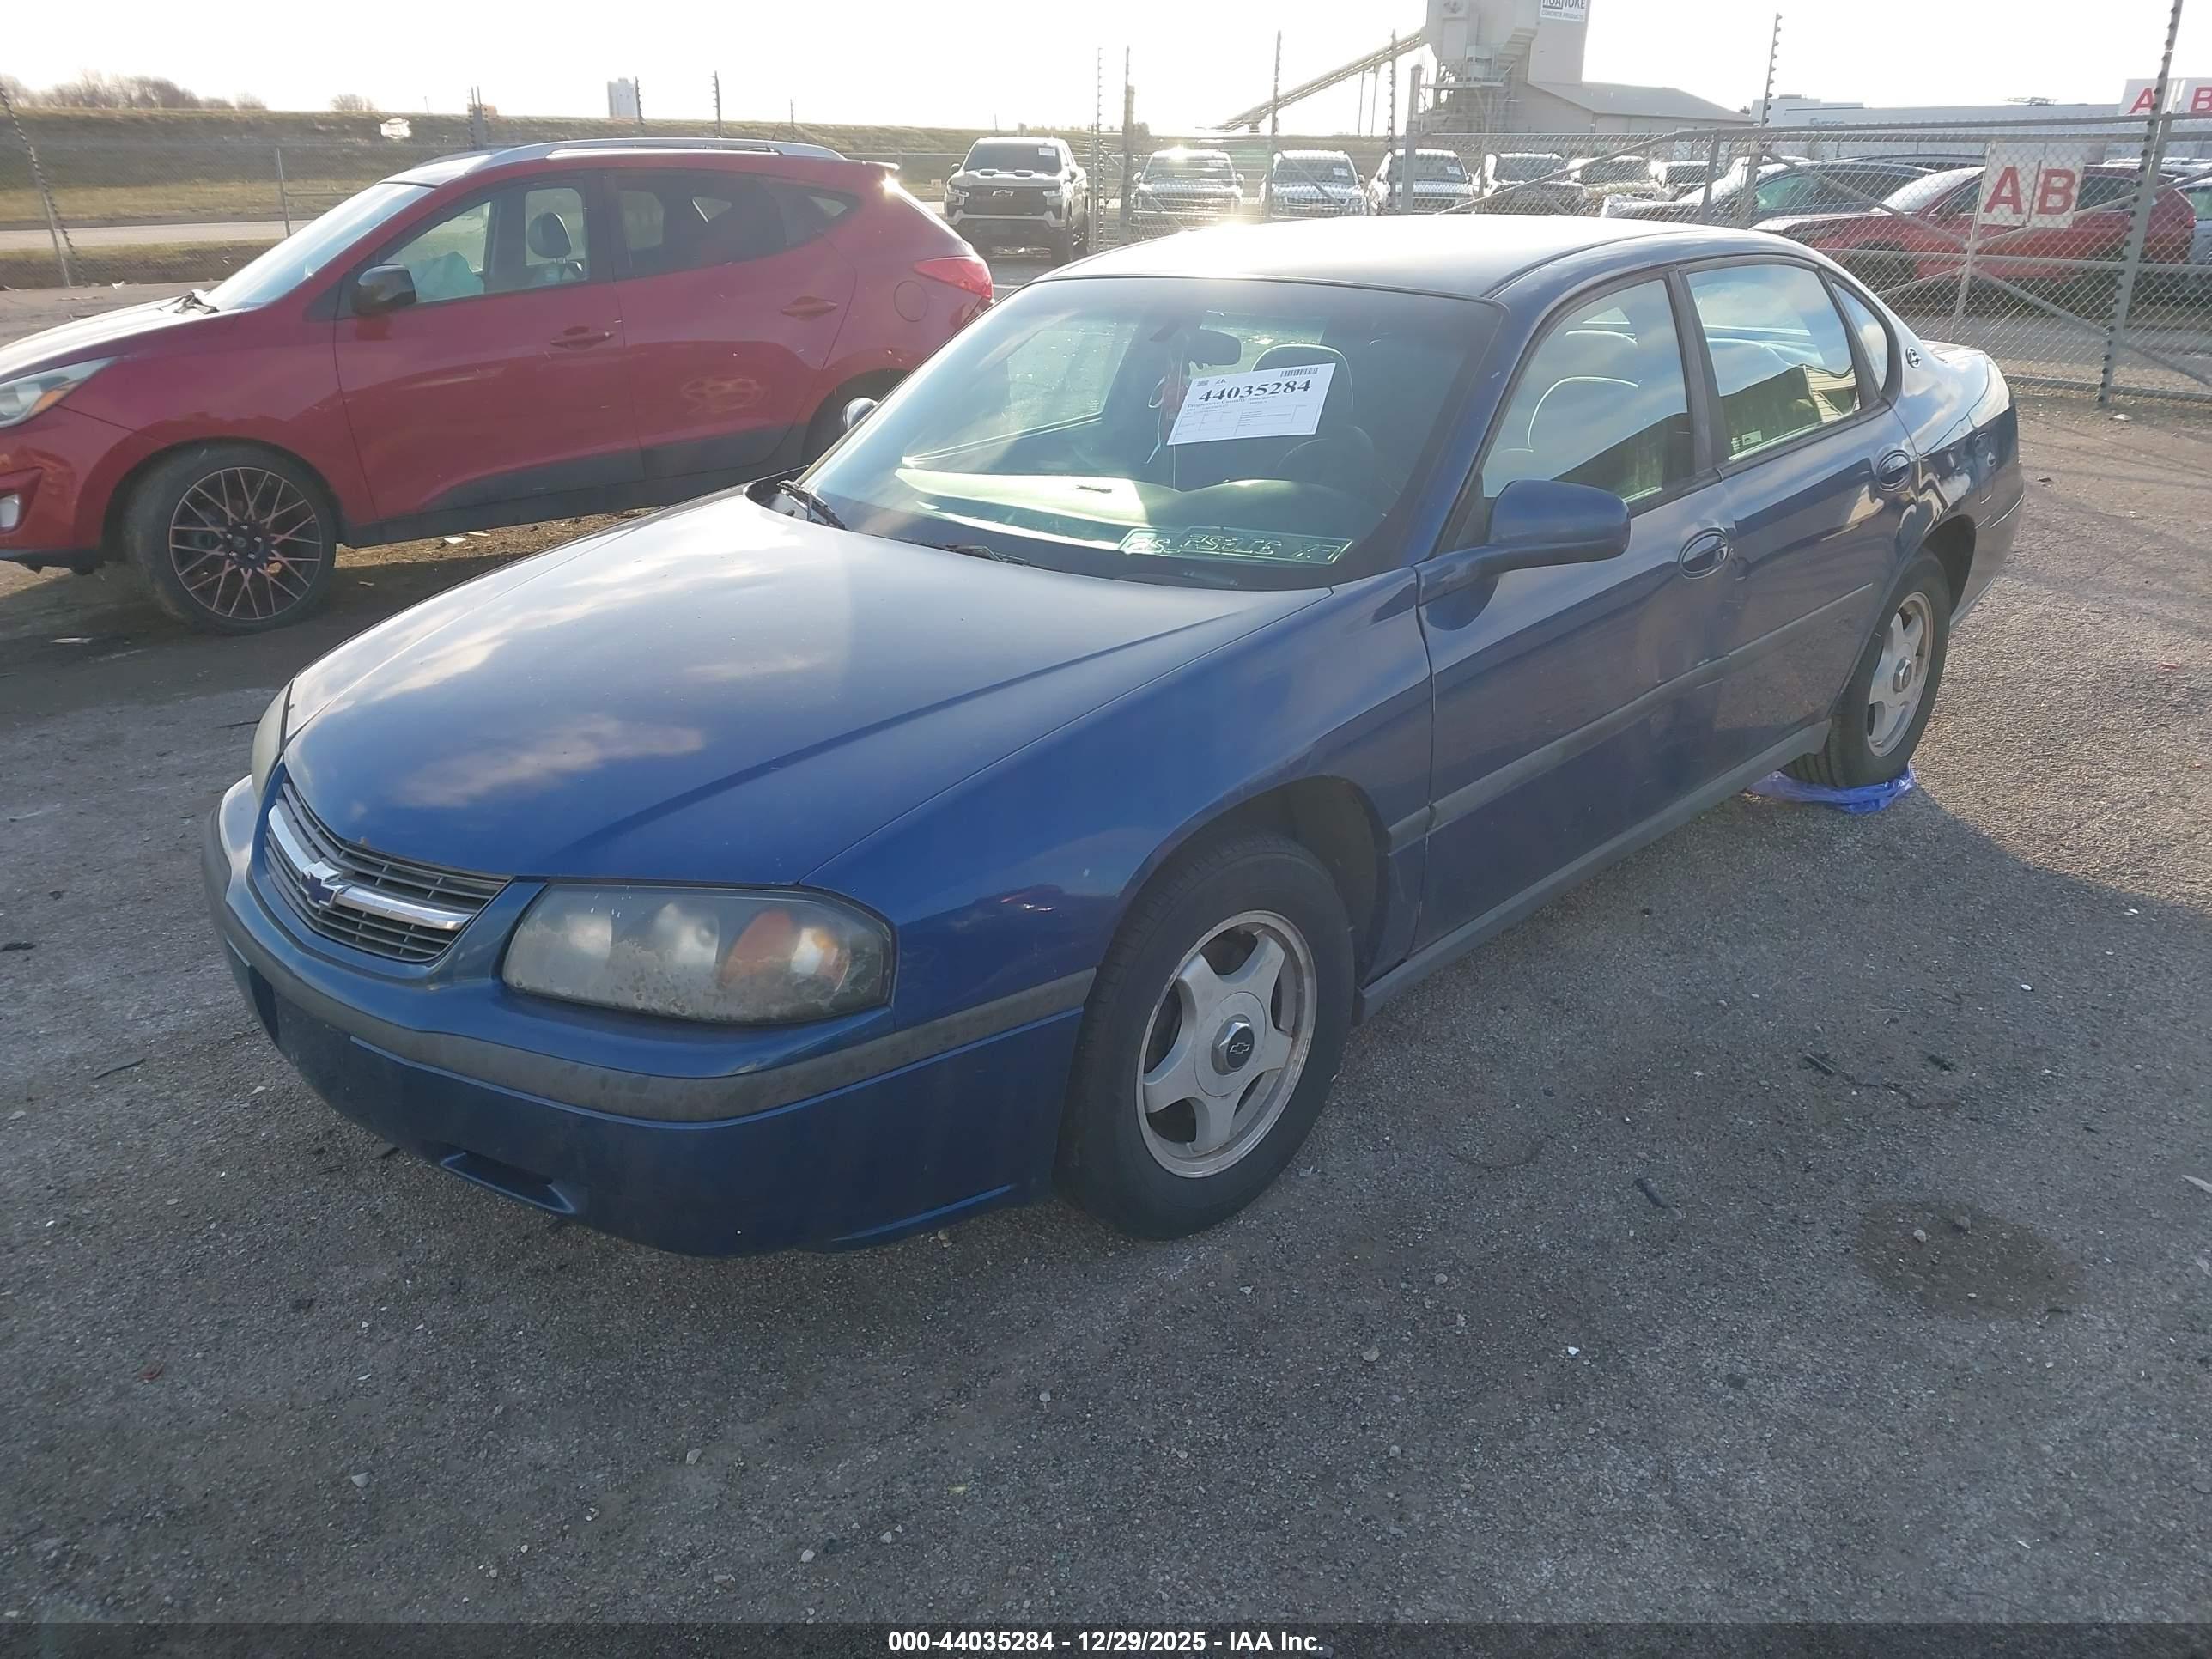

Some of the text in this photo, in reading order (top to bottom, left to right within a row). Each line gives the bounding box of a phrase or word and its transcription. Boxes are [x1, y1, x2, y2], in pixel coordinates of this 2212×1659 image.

[2129, 87, 2212, 114] A B
[1983, 166, 2076, 215] A B
[1199, 379, 1311, 402] 44035284
